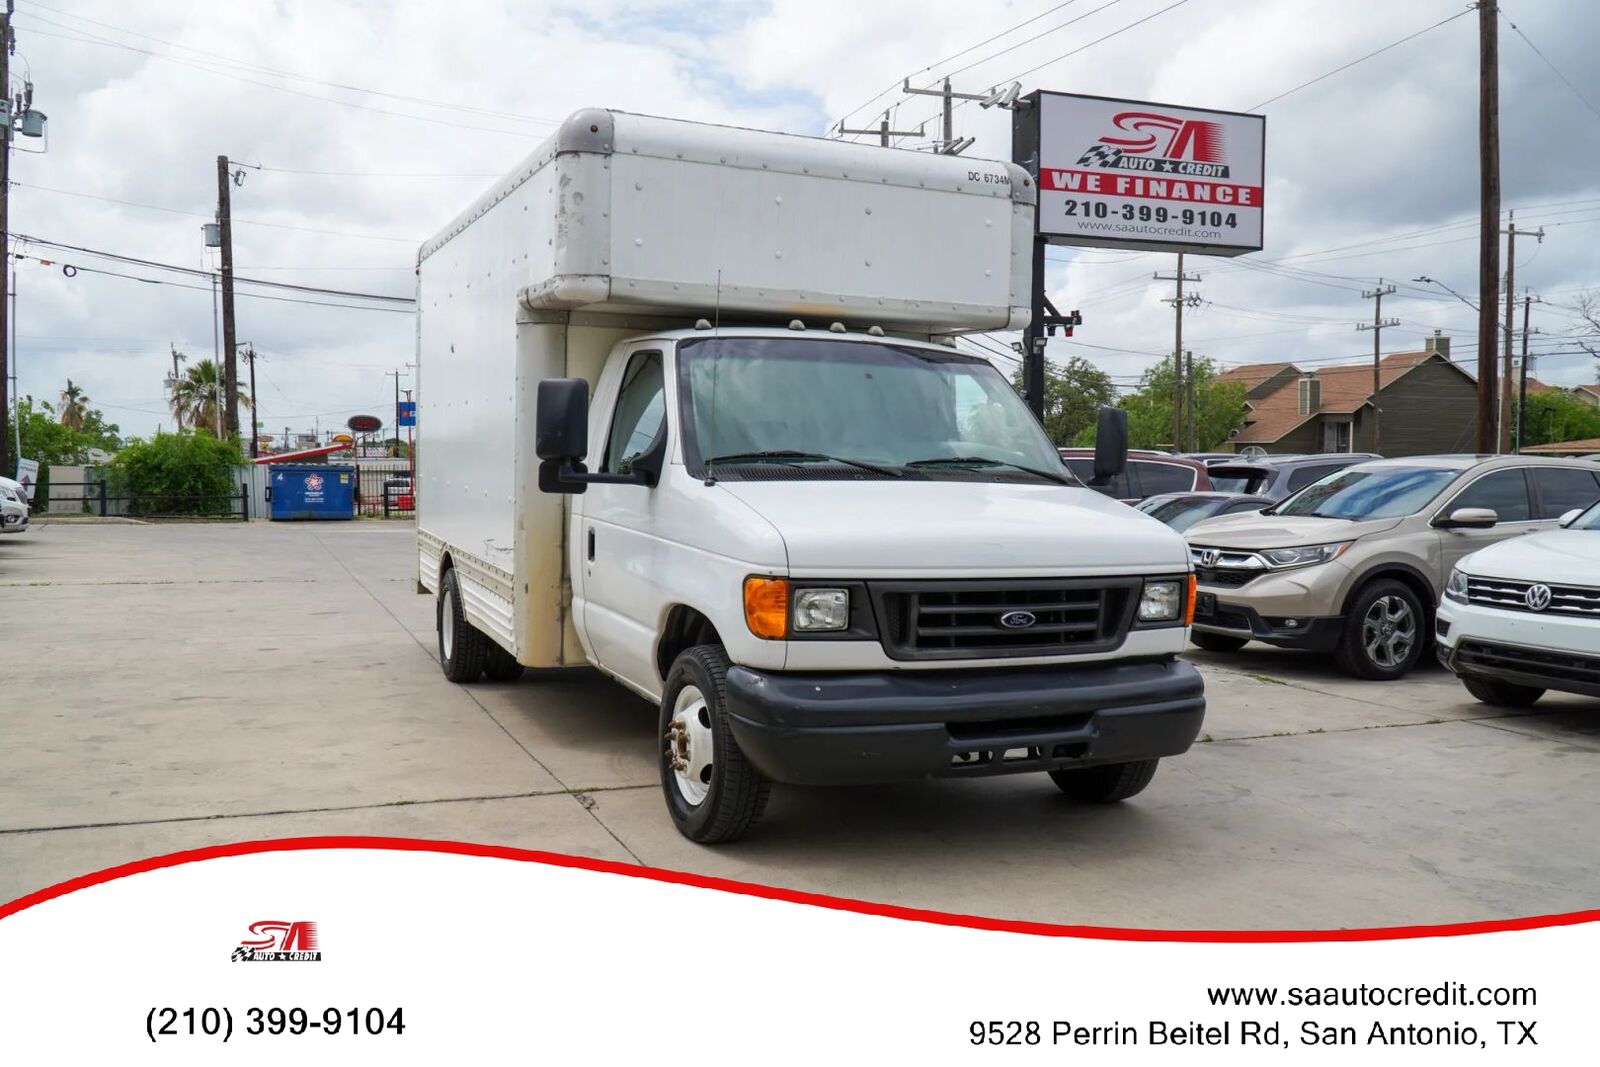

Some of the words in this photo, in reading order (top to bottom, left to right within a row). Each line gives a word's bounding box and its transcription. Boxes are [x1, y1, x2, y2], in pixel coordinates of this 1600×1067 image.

[967, 171, 981, 182] DC
[1118, 156, 1156, 171] AUTO
[1178, 162, 1225, 177] CREDIT
[1051, 171, 1101, 192] WE
[1116, 176, 1251, 204] FINANCE
[1064, 199, 1238, 229] 210-399-9104
[1077, 221, 1222, 239] www.saautocredit.com
